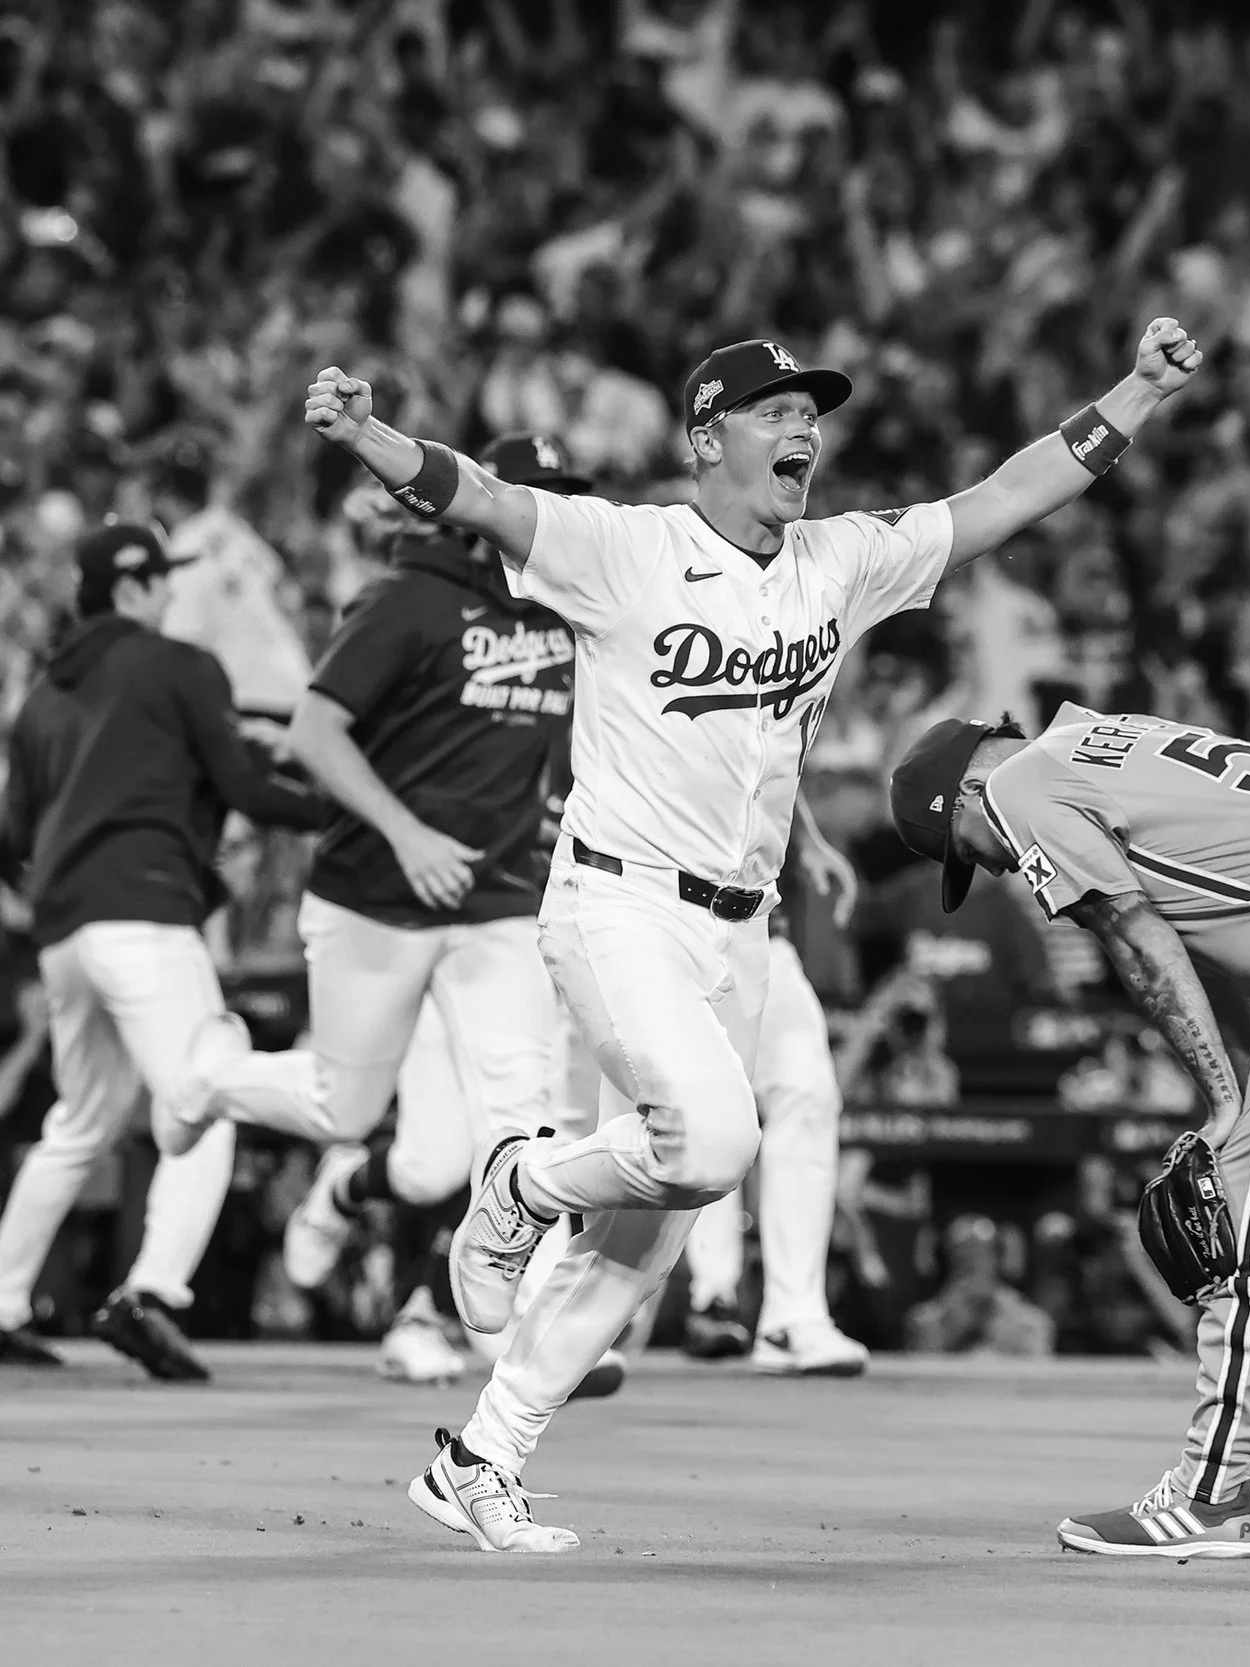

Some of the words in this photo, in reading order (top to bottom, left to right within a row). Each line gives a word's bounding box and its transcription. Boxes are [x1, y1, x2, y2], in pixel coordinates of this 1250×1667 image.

[763, 343, 799, 373] LA
[1071, 424, 1110, 462] Franklin
[461, 620, 576, 685] Dodgers
[650, 617, 841, 721] Dodgers
[1240, 1522, 1250, 1539] P
